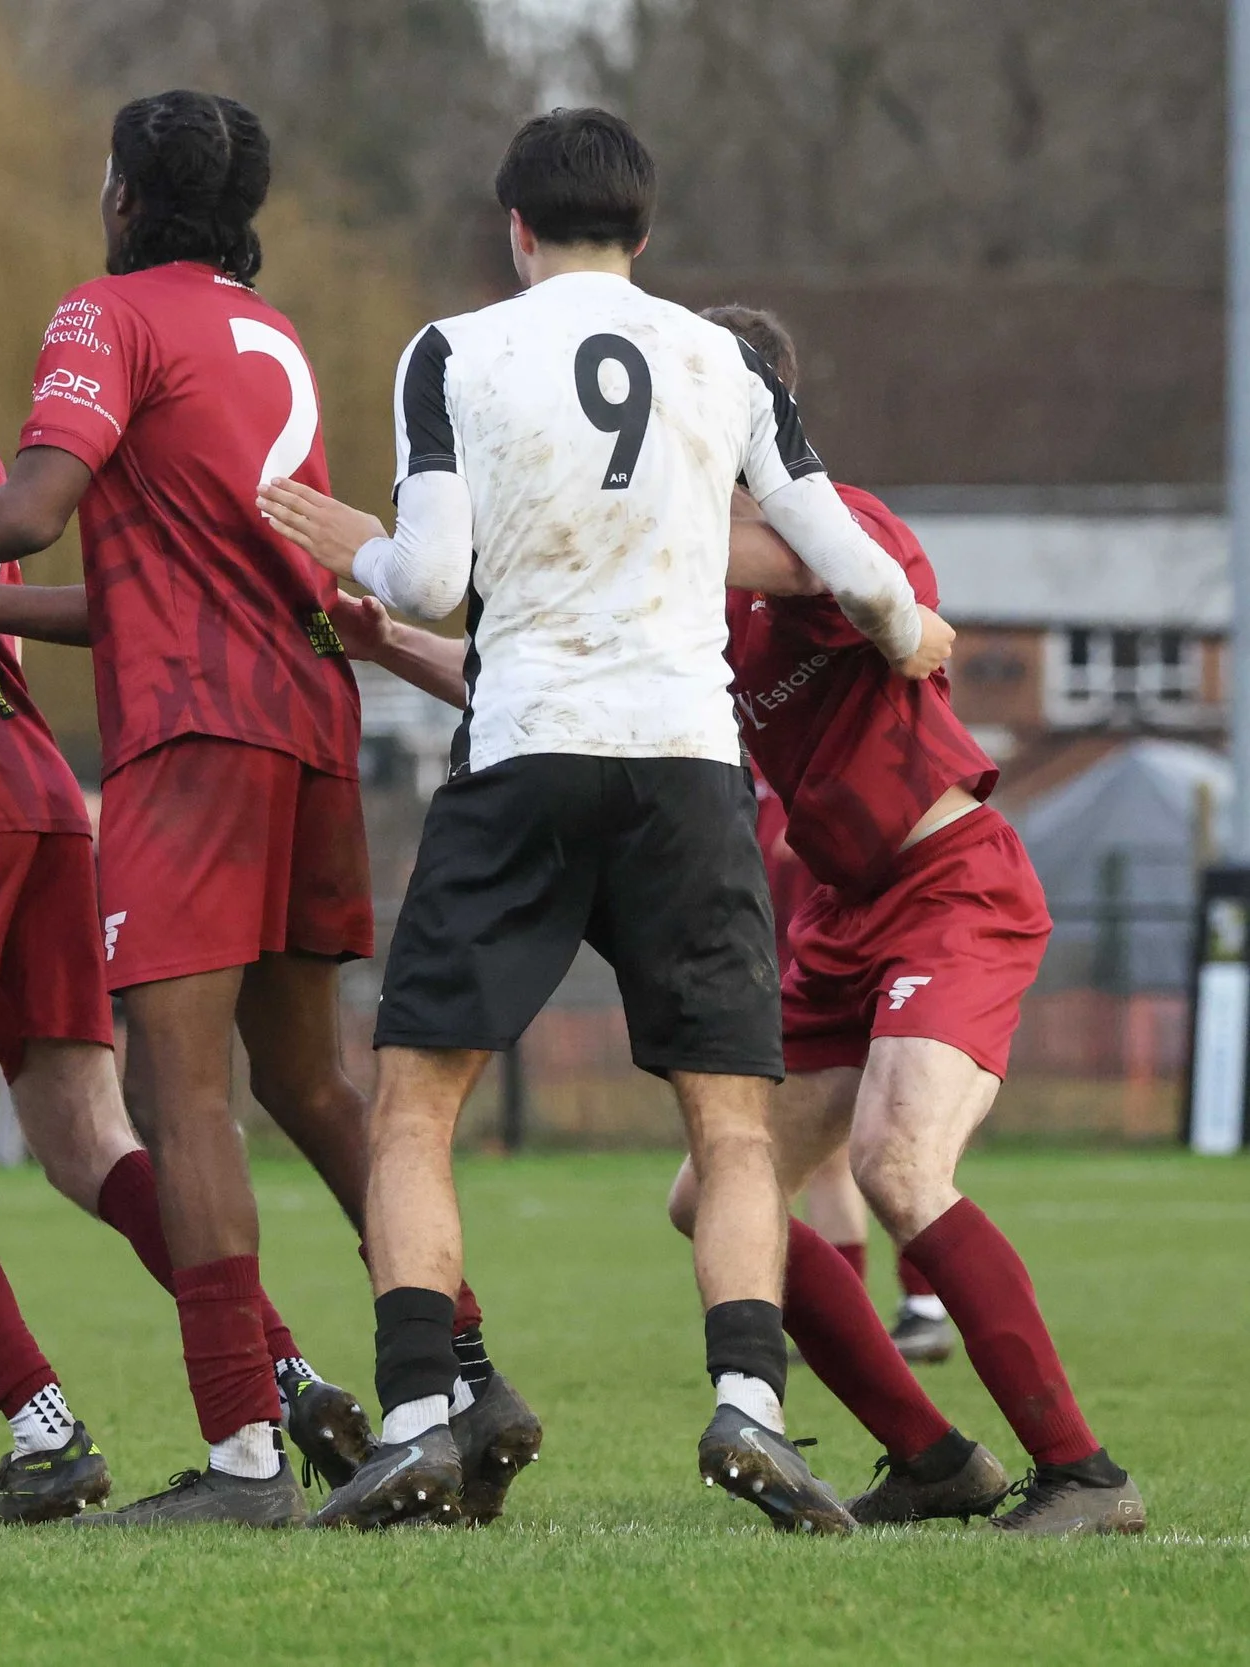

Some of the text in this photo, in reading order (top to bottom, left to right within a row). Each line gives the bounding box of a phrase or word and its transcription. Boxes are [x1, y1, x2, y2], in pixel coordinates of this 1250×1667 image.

[55, 298, 103, 317] harles
[46, 313, 96, 332] ussell
[42, 328, 112, 356] peechlys
[39, 368, 101, 400] EDR
[63, 391, 94, 409] Digital
[574, 333, 653, 490] 9
[228, 317, 319, 518] 2
[610, 473, 628, 483] AR
